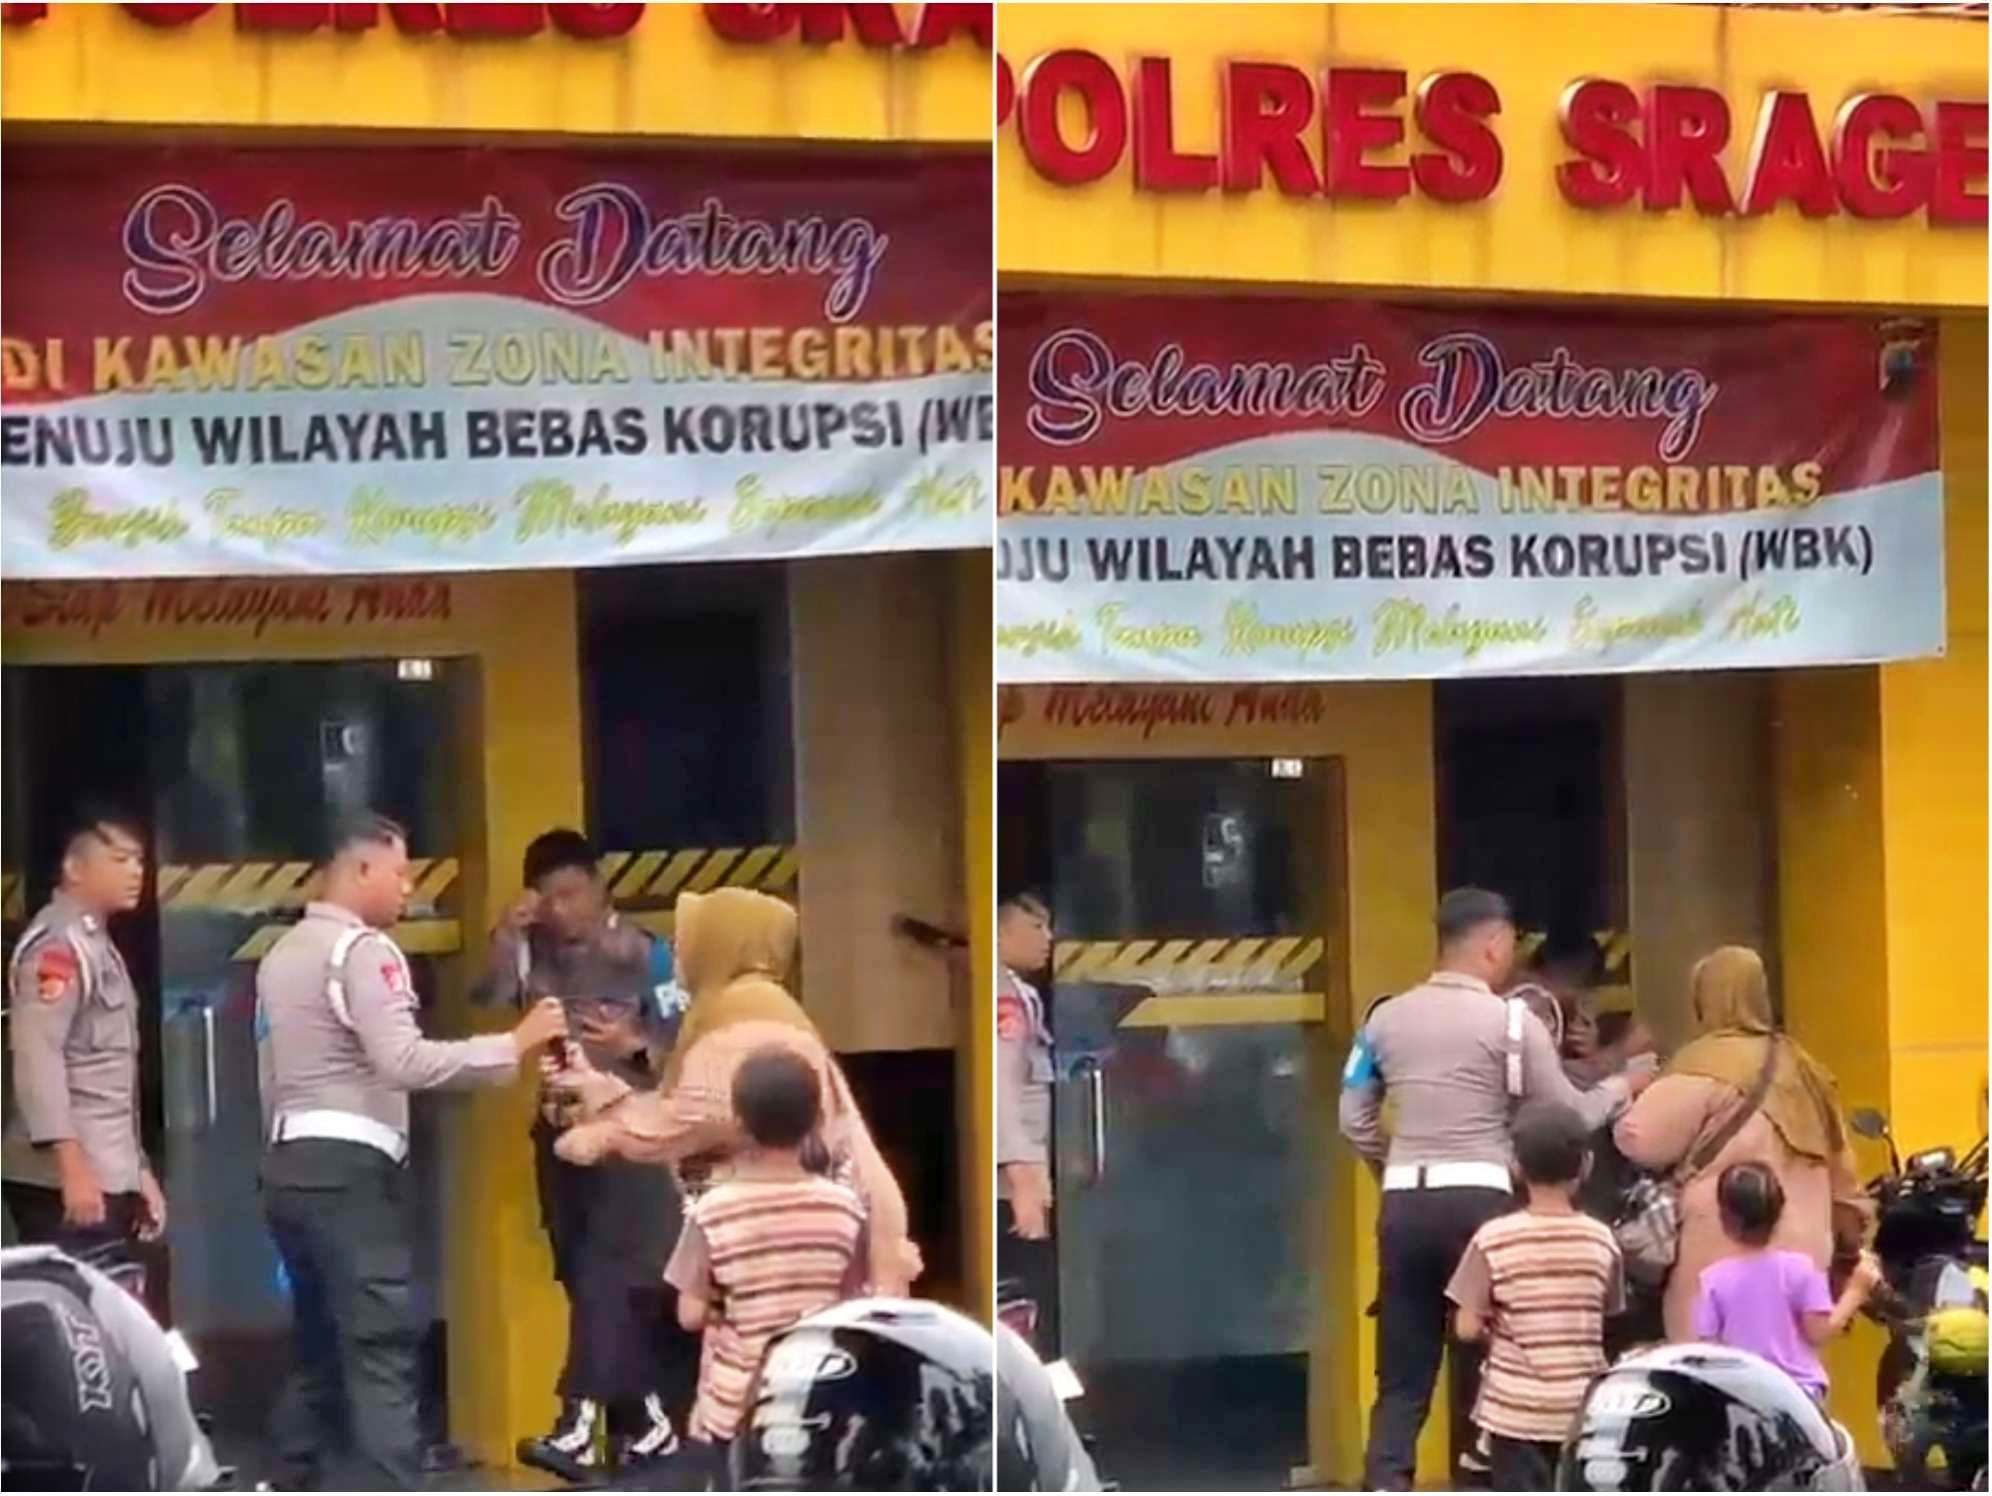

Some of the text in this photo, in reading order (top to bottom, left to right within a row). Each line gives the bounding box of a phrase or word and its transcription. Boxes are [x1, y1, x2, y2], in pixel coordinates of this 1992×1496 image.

[996, 47, 1503, 201] OLRES
[122, 182, 888, 323] Selamat Datang
[2, 320, 992, 395] DI KAWASAN ZONA INTEGRITAS
[1026, 328, 1720, 464] Selamat Datang
[2, 414, 174, 467] ENUJU
[192, 411, 447, 465] WILAYAH
[467, 406, 648, 459] BEBAS
[664, 401, 903, 455] KORUPSI
[999, 461, 1824, 516] KAWASAN ZONA INTEGRITAS
[1085, 534, 1317, 582] WILAYAH
[1332, 533, 1495, 580] BEBAS
[1510, 532, 1726, 580] KORUPSI
[1740, 524, 1874, 581] (WBK)
